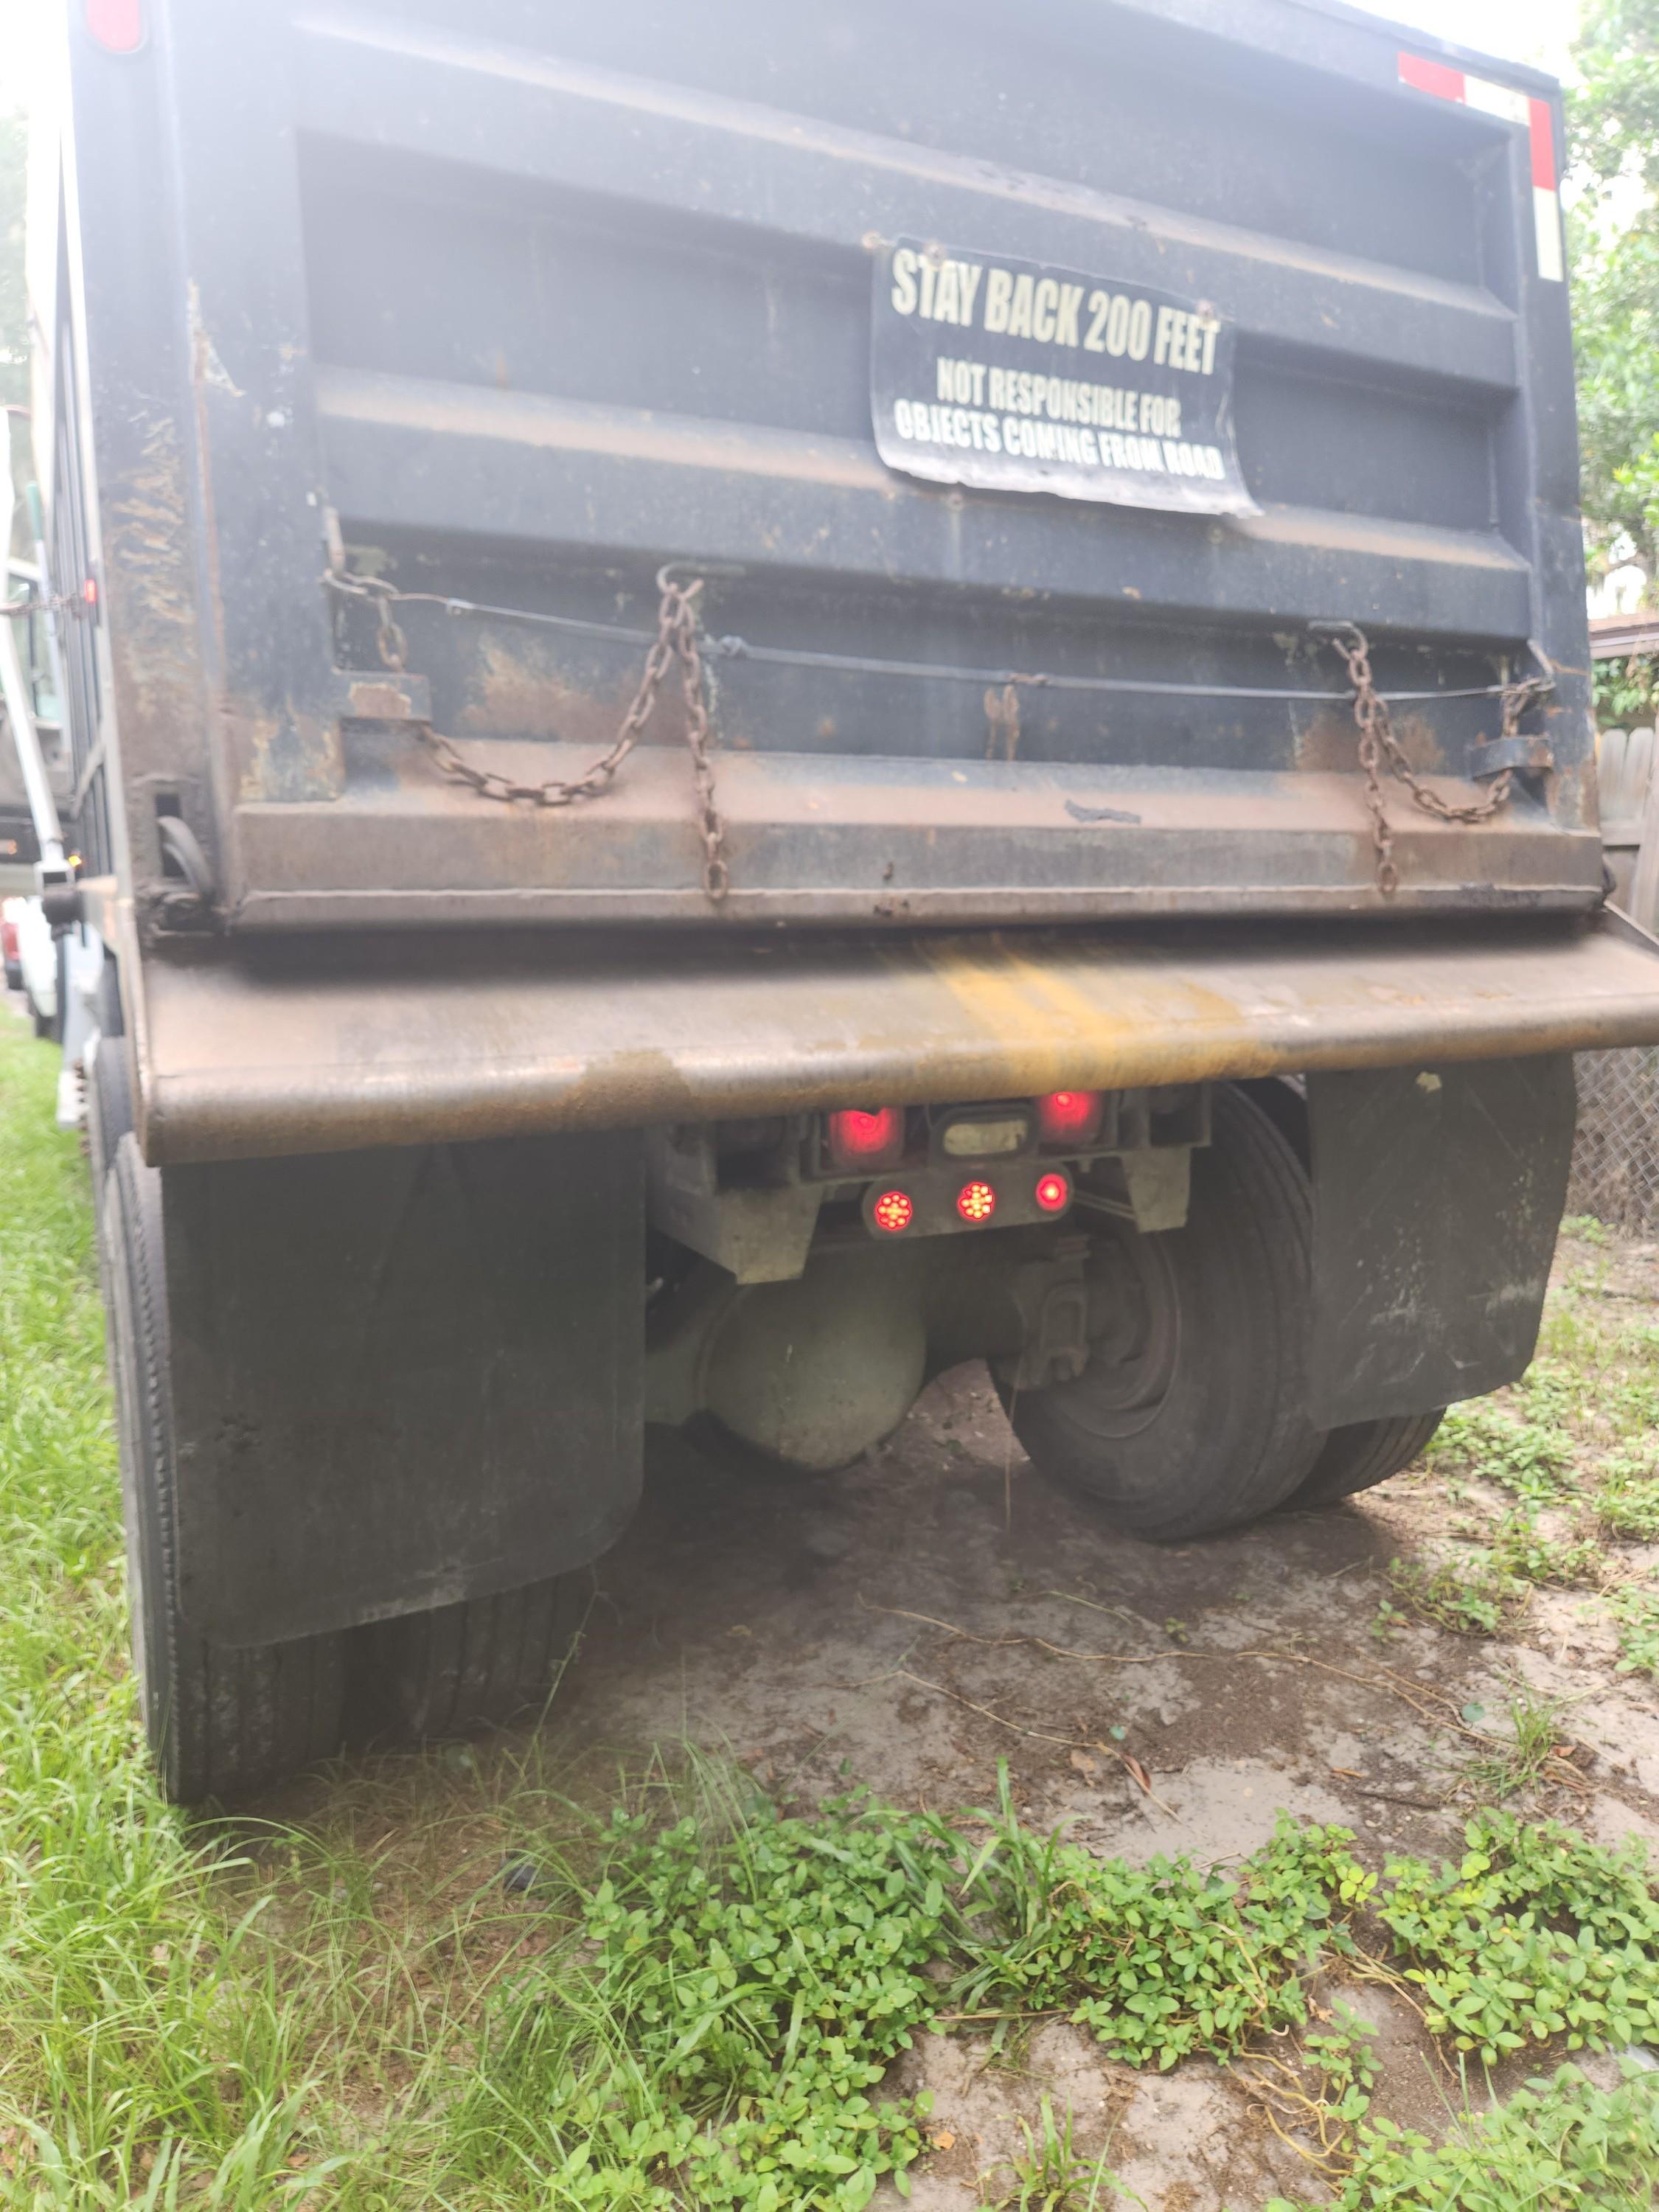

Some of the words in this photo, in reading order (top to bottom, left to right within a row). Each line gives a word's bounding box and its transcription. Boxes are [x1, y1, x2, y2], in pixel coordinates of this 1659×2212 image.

[891, 248, 981, 327] STAY
[984, 269, 1085, 347] BACK
[1086, 291, 1152, 361] 200
[1154, 306, 1221, 375] FEET
[936, 357, 987, 406] NOT
[989, 367, 1138, 432] RESPONSIBLE
[1139, 393, 1181, 438] FOR
[894, 399, 1001, 453] OBJECTS
[1002, 416, 1099, 467] COMING
[1098, 431, 1166, 473] FROM
[1163, 441, 1225, 481] ROAD
